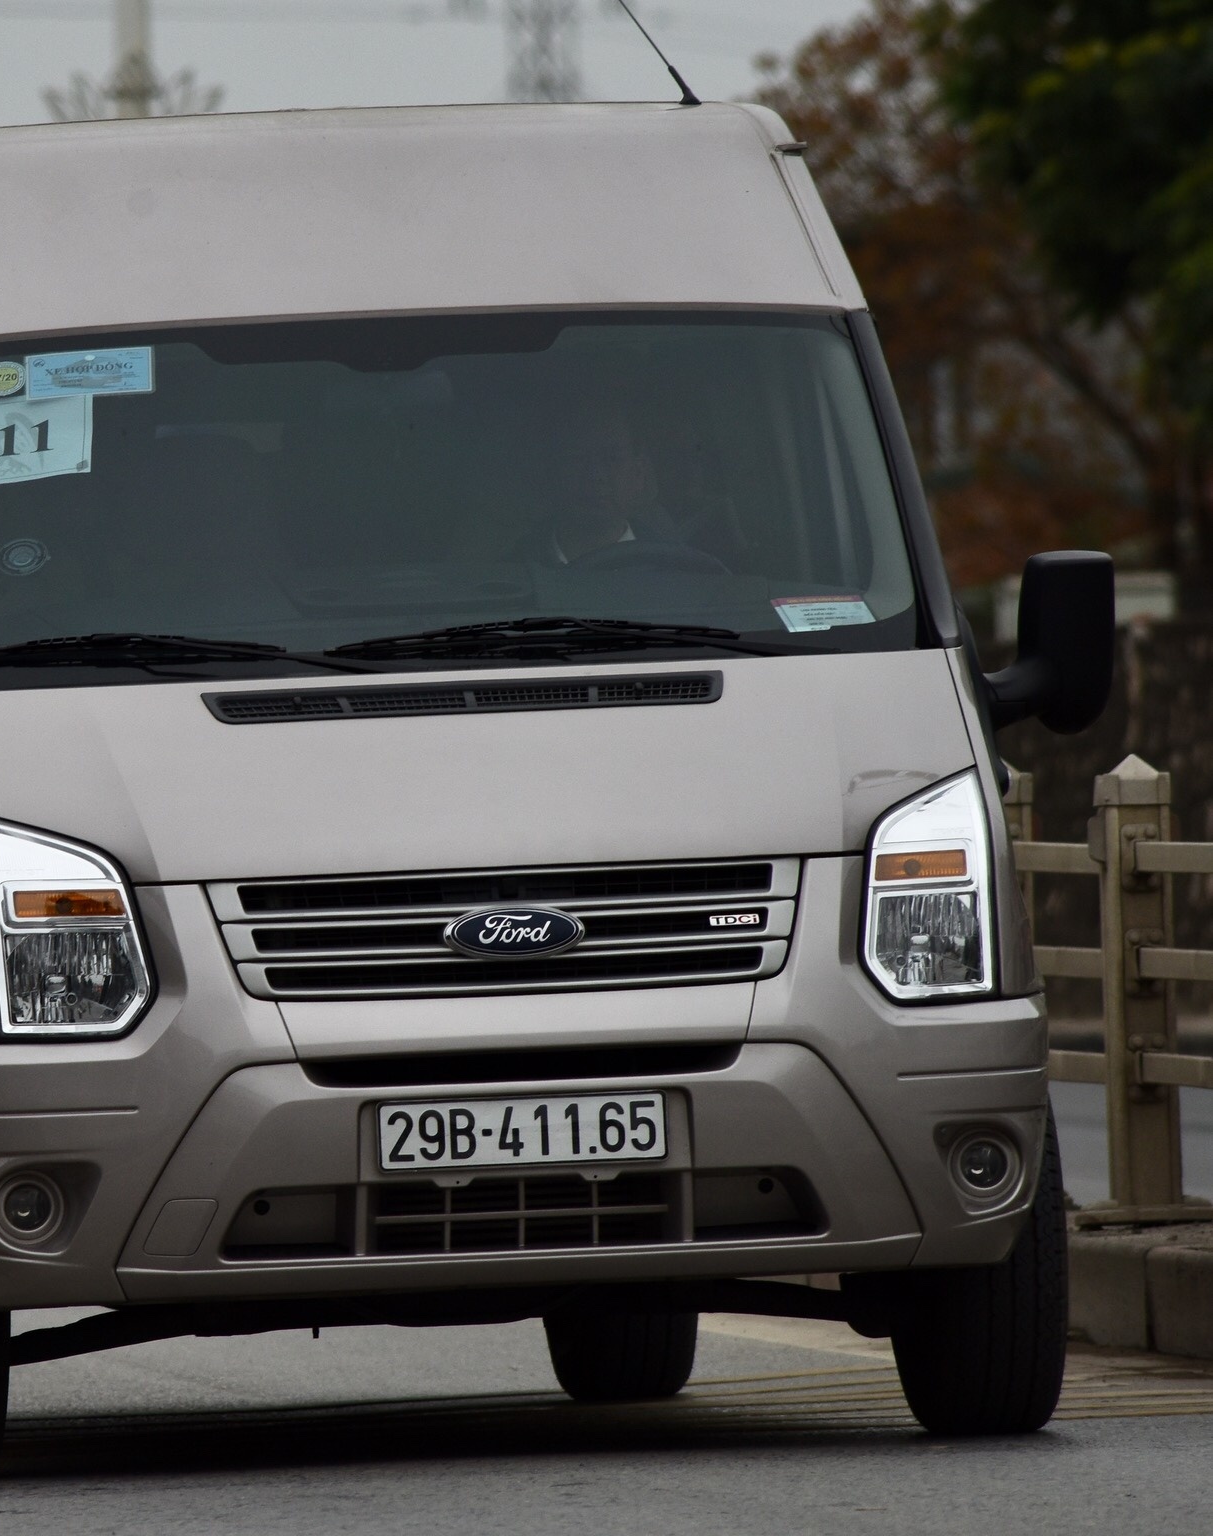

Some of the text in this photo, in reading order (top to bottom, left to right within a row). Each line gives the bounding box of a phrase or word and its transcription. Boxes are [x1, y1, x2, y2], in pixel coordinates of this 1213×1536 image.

[45, 367, 65, 376] XE
[479, 914, 550, 944] Ford
[387, 1100, 656, 1163] 29B-411.65
